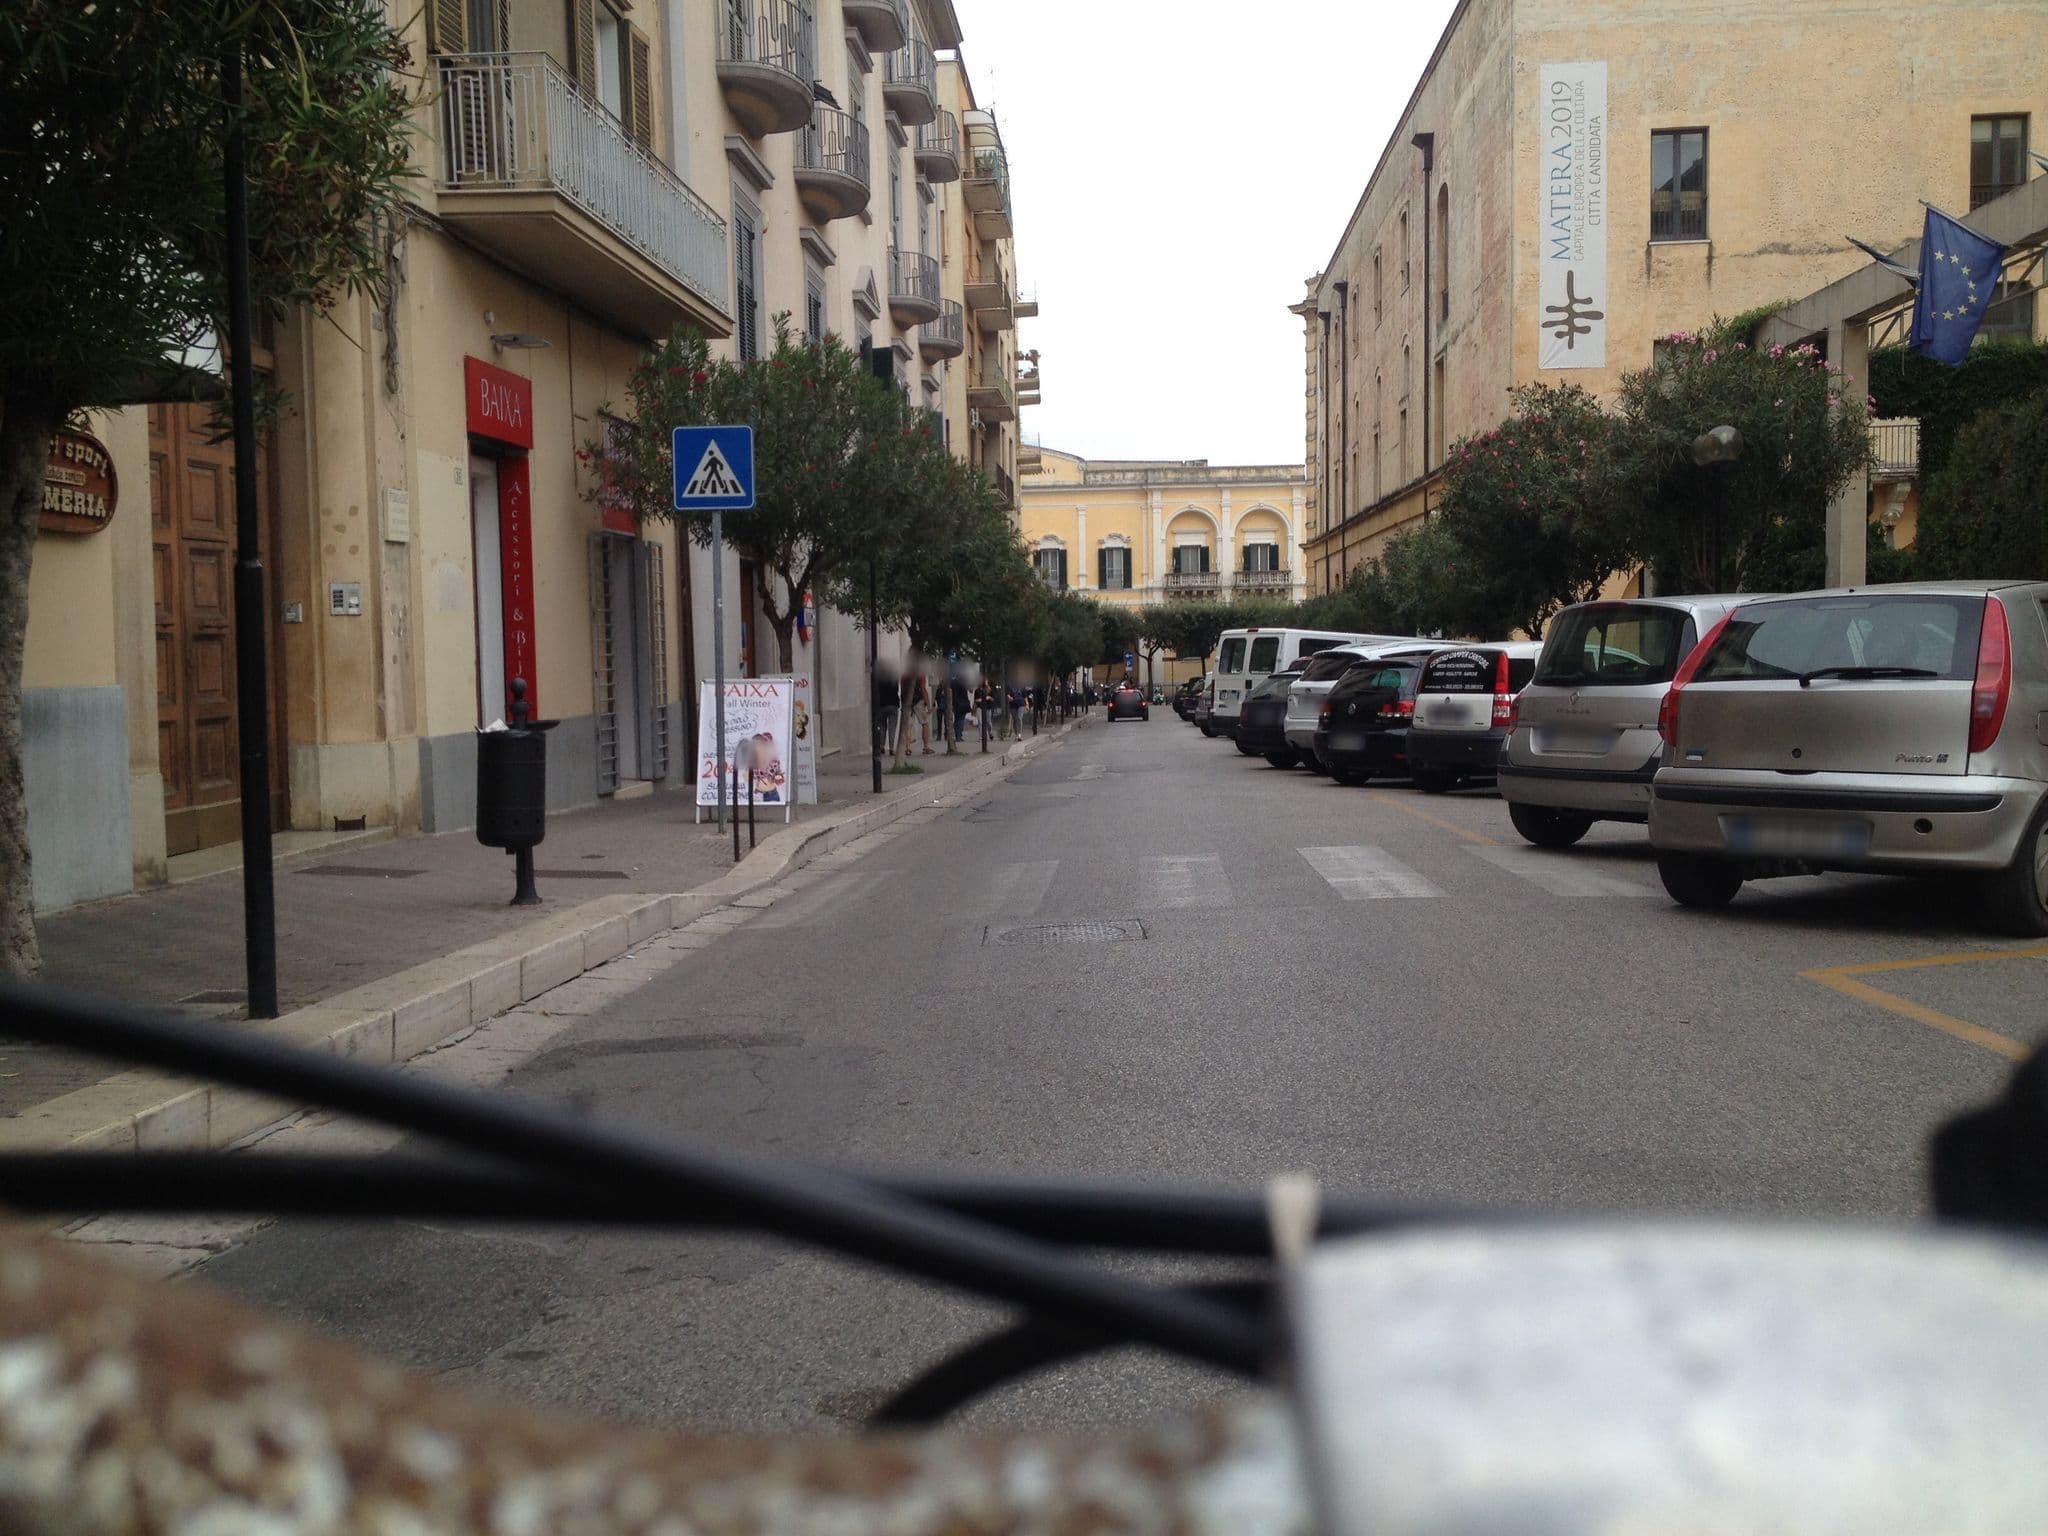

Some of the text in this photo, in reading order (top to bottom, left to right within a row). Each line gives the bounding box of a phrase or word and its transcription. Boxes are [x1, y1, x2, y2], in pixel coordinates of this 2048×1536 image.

[1551, 80, 1572, 261] MATERA 2019
[1574, 80, 1585, 262] CAPITALE EUROPEA DELLA CULTURA
[1588, 115, 1601, 185] CANDIDATA
[480, 378, 522, 428] BAIXA
[44, 486, 106, 517] MERIA
[509, 480, 526, 676] Accessori & Bij
[724, 683, 779, 697] AIXA
[726, 699, 771, 708] all Winter
[1895, 752, 1933, 763] Punto
